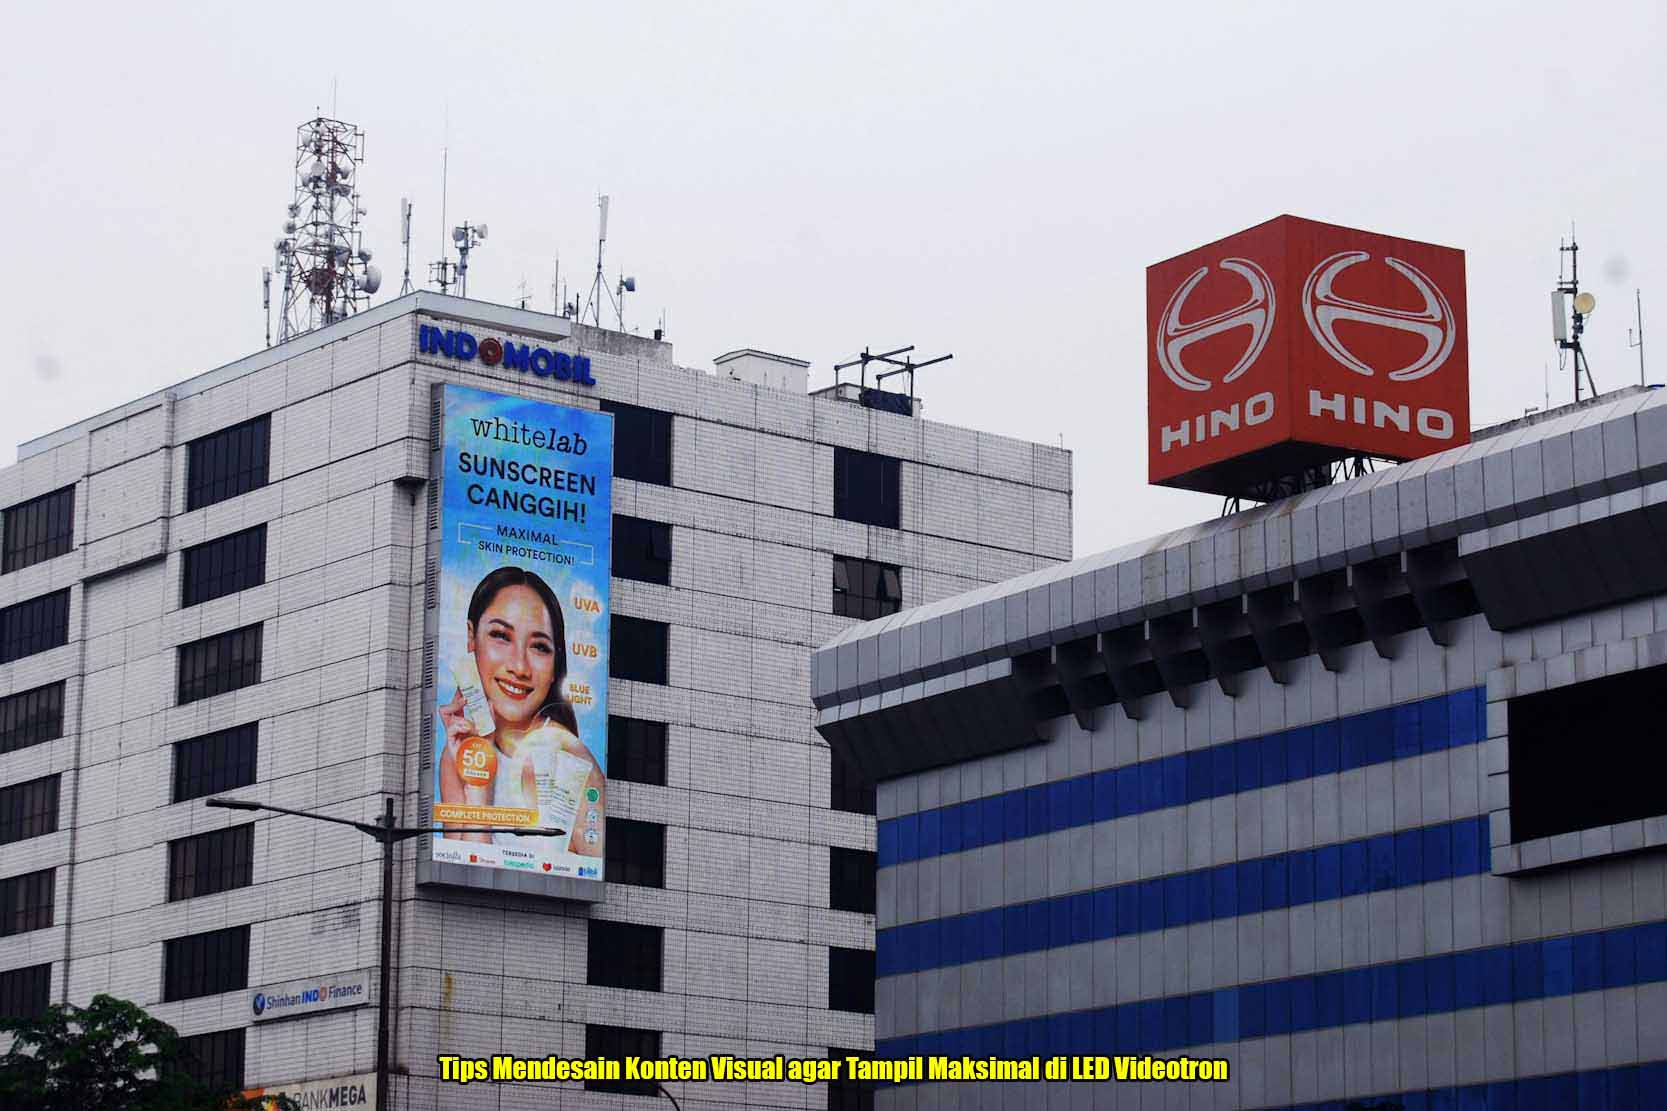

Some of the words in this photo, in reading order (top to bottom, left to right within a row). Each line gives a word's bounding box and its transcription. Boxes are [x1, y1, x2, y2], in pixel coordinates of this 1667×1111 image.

[418, 324, 596, 385] INDOMOBIL
[1161, 391, 1275, 453] HINO
[1308, 389, 1454, 440] HINO
[470, 416, 588, 456] whitelab
[458, 451, 596, 496] SUNSCREEN
[467, 483, 587, 524] CANGGIH!
[496, 524, 559, 546] MAXIMAL
[478, 540, 503, 554] SKIN
[505, 544, 575, 565] PROTECTION!
[574, 597, 600, 613] UVA
[572, 643, 597, 658] UVB
[569, 683, 591, 694] BLUE
[463, 749, 486, 769] 50
[266, 993, 301, 1009] Shinhan
[329, 984, 362, 998] Finance
